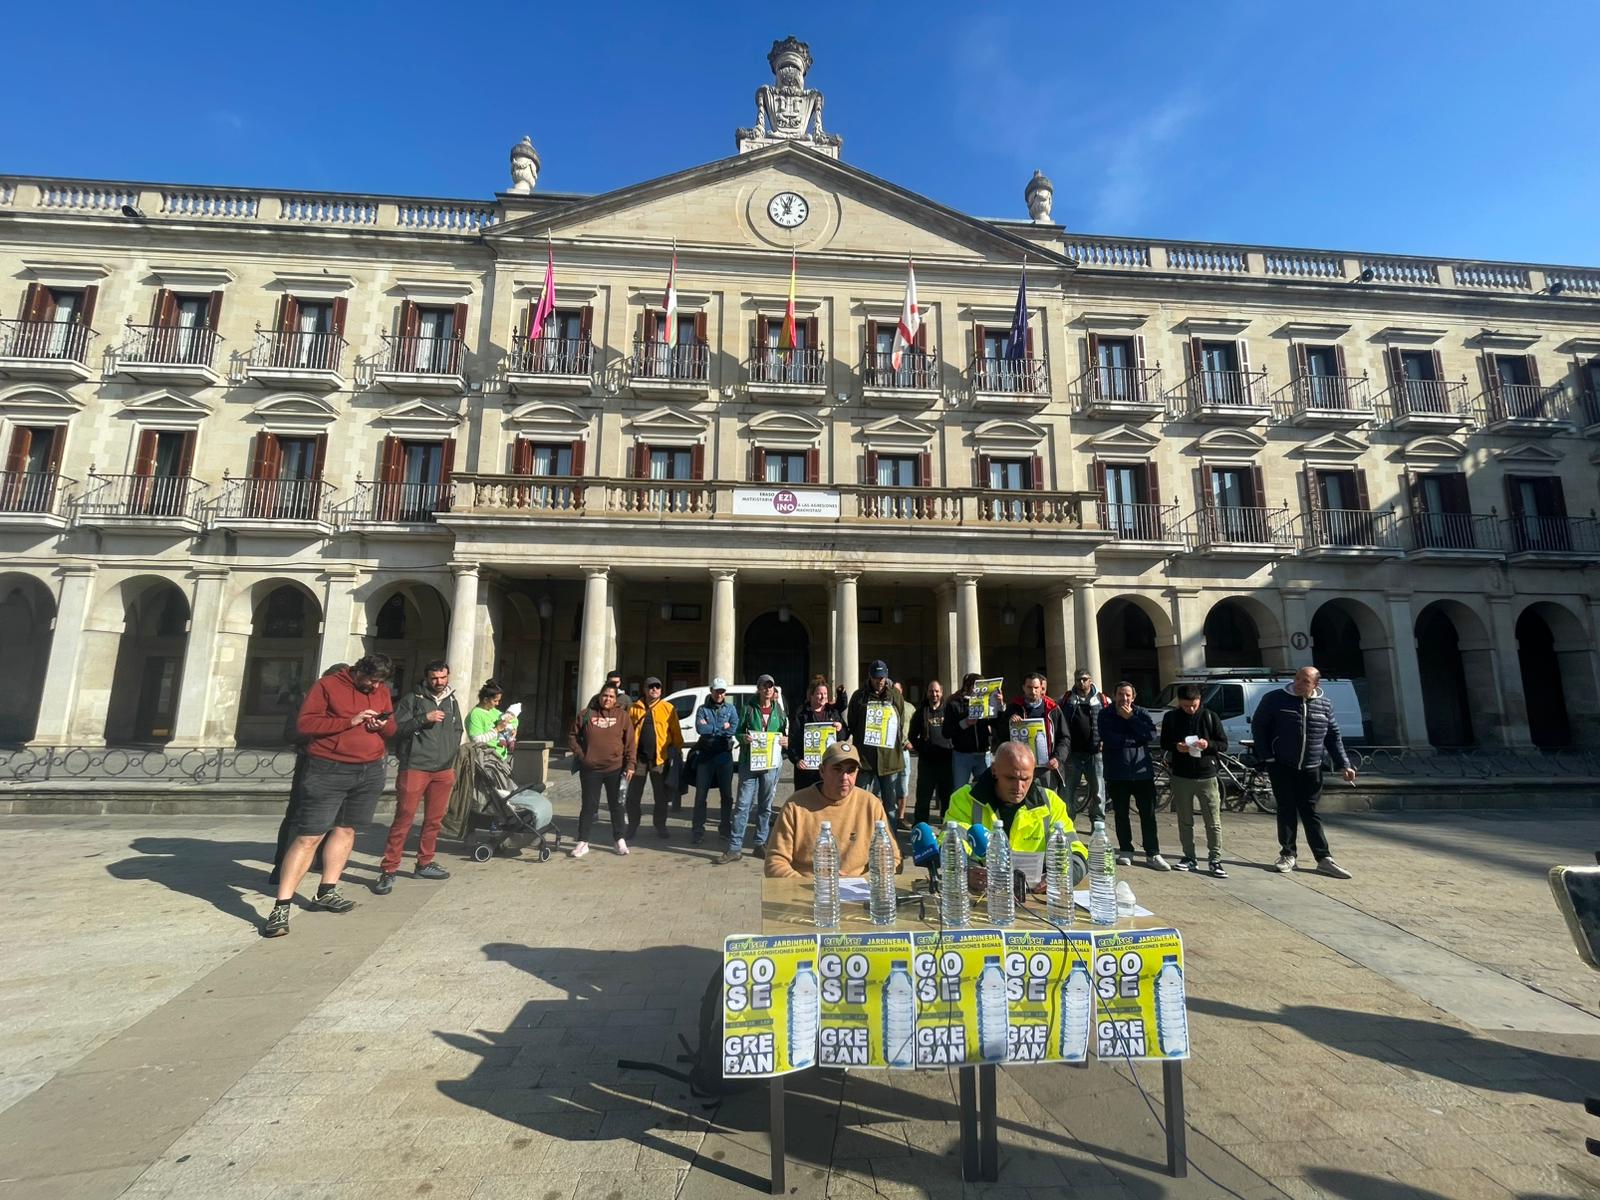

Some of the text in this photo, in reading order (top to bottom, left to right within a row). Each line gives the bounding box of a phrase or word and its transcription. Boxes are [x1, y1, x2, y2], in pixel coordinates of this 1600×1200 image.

[773, 938, 815, 947] JARDINERIA
[917, 934, 1000, 944] envier JARDINERIA
[1008, 931, 1044, 945] enviser
[725, 957, 775, 985] GO
[820, 954, 869, 978] GO
[915, 951, 963, 977] GO
[1006, 952, 1051, 977] GO
[1096, 952, 1142, 976] GO
[726, 983, 772, 1011] SE
[822, 978, 866, 1004] SE
[916, 976, 961, 1002] SE
[1007, 976, 1046, 1001] SE
[1098, 975, 1139, 999] SE
[821, 1028, 869, 1046] GRE
[918, 1025, 965, 1046] GRE
[1008, 1025, 1048, 1044] GRE
[1098, 1019, 1144, 1039] GRE
[725, 1033, 774, 1055] GRE
[918, 1044, 965, 1064] BAN
[1098, 1038, 1145, 1057] BAN
[725, 1054, 774, 1074] BAN
[821, 1046, 868, 1065] BAN
